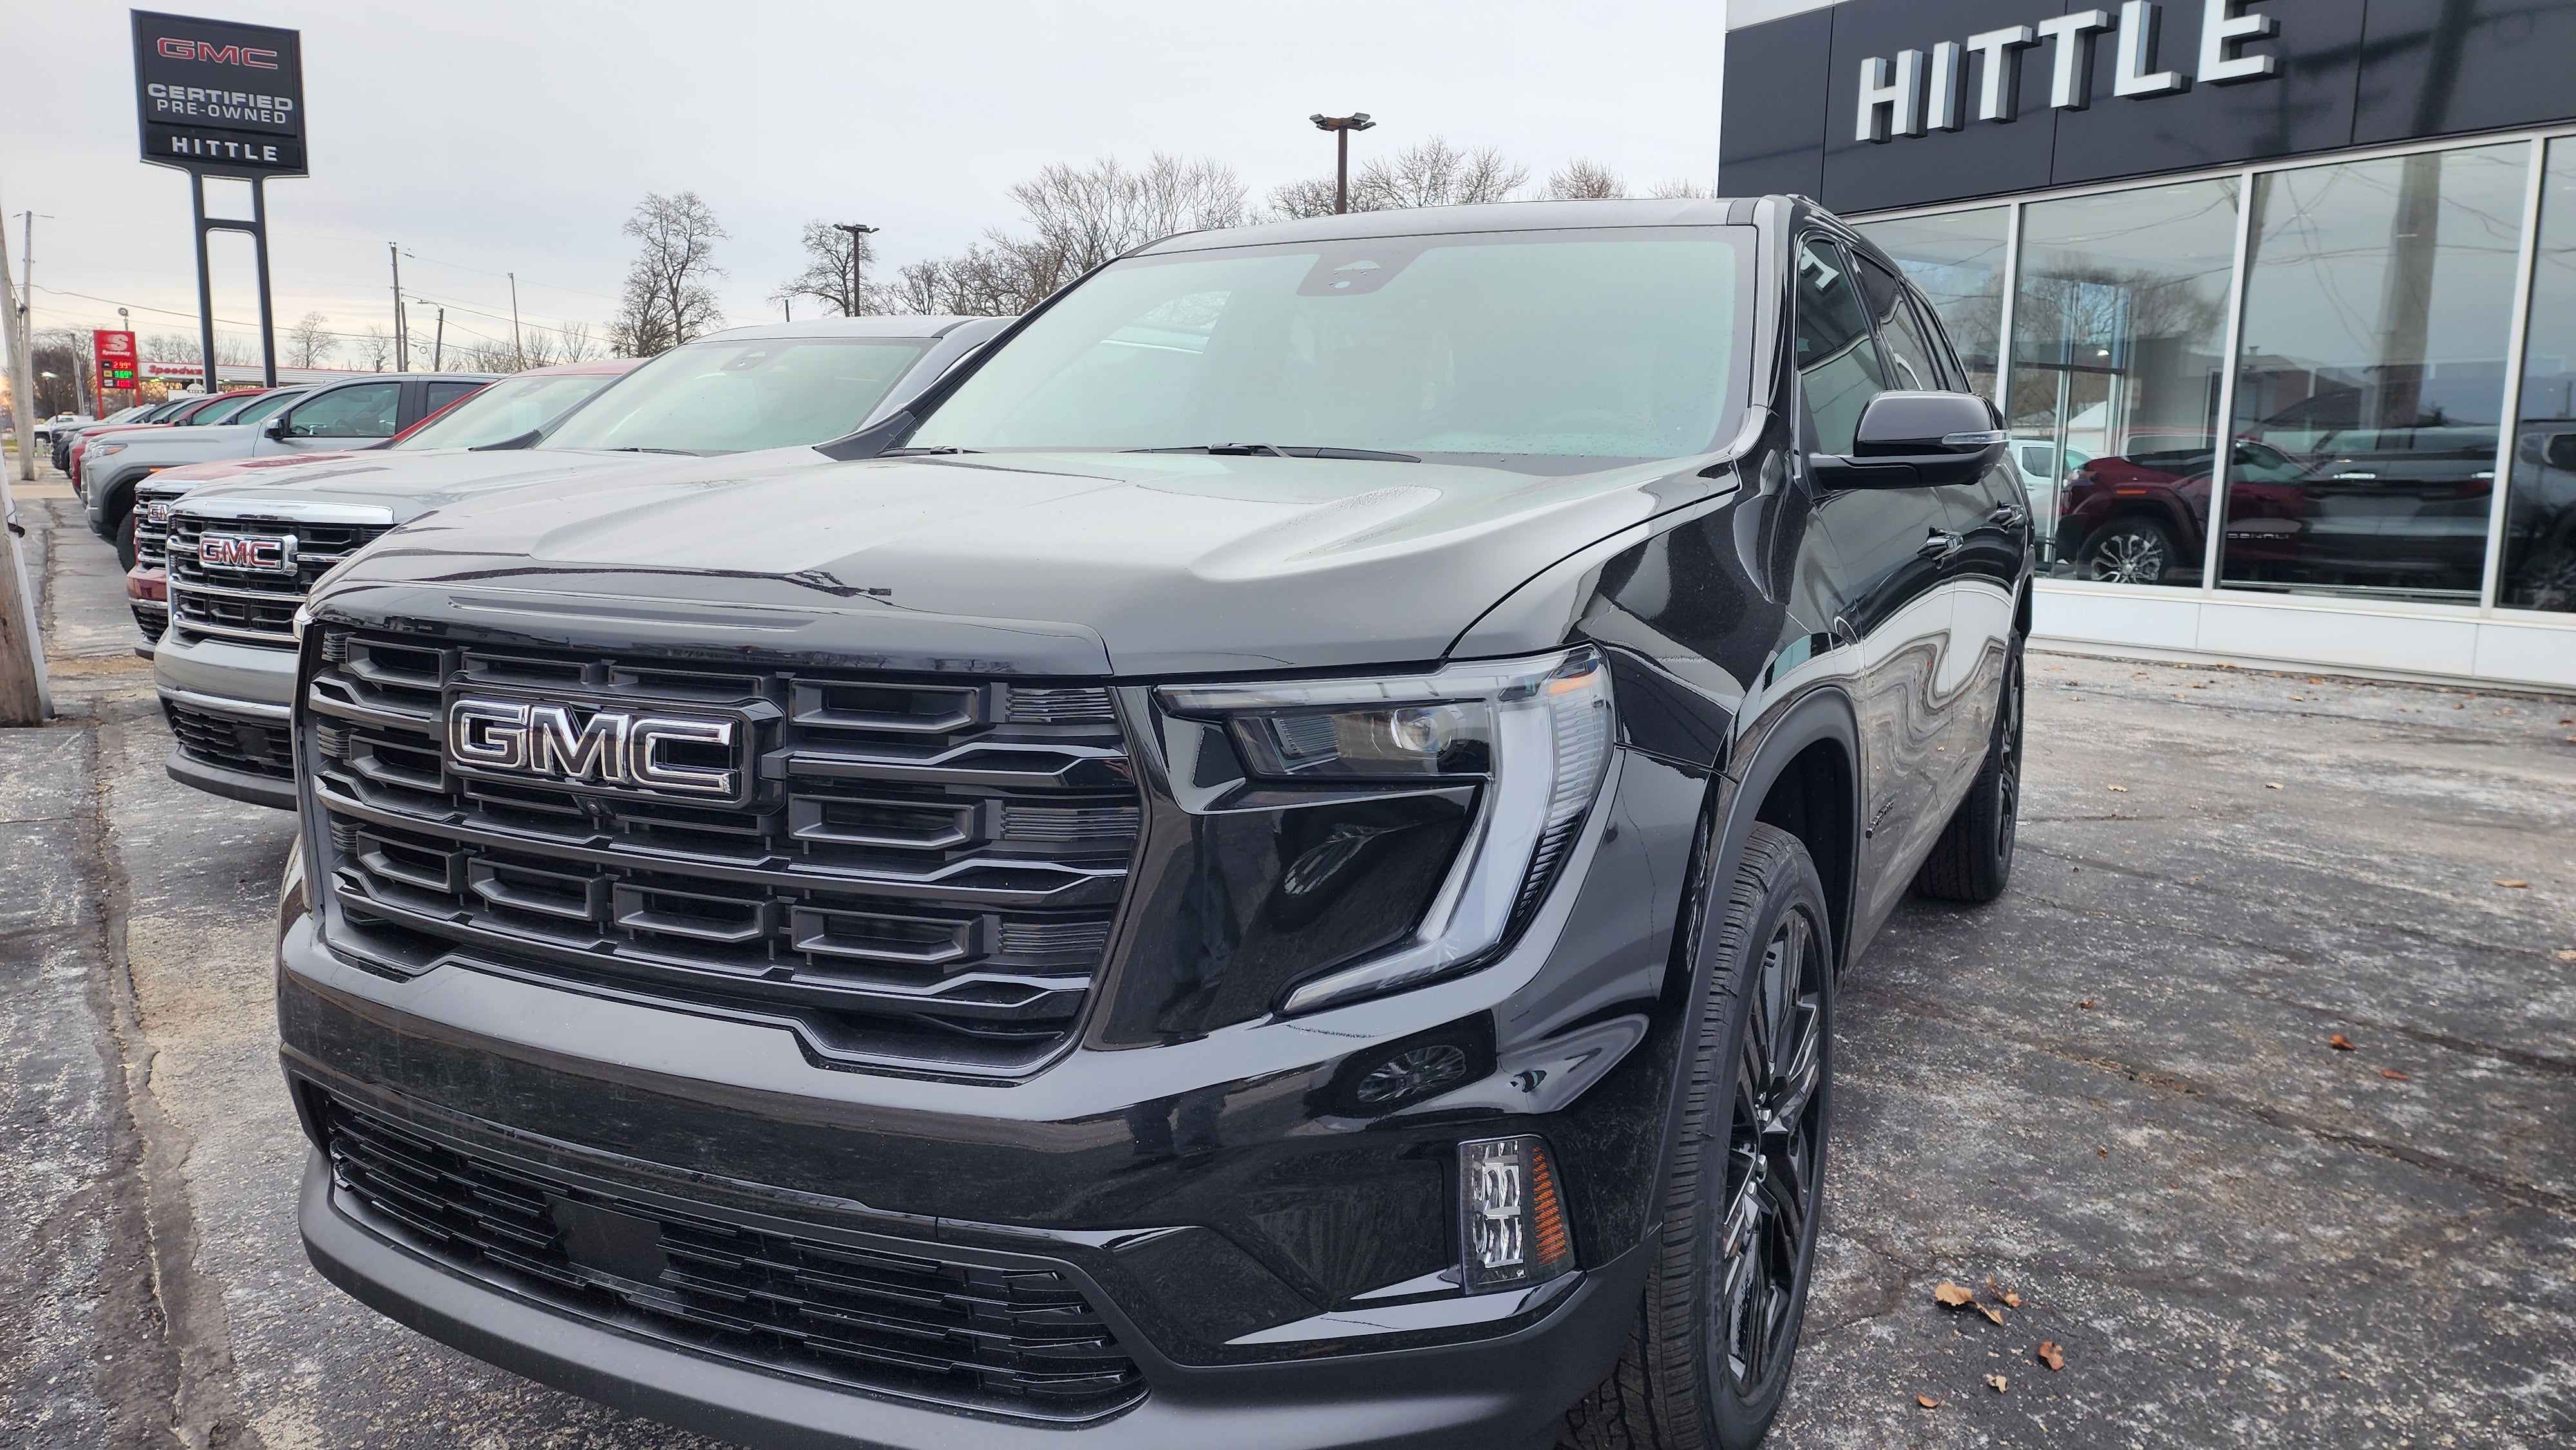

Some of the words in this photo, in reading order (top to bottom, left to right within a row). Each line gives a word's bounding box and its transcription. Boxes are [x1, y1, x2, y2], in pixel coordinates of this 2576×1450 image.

[156, 37, 278, 70] GMC
[1855, 0, 2277, 142] HITTLE
[147, 82, 293, 111] CERTIFIED
[156, 99, 286, 124] PRE-OWNED
[171, 136, 278, 161] HITTLE
[148, 364, 204, 375] Speedwa
[200, 538, 282, 568] GMC
[450, 699, 734, 795] GMC
